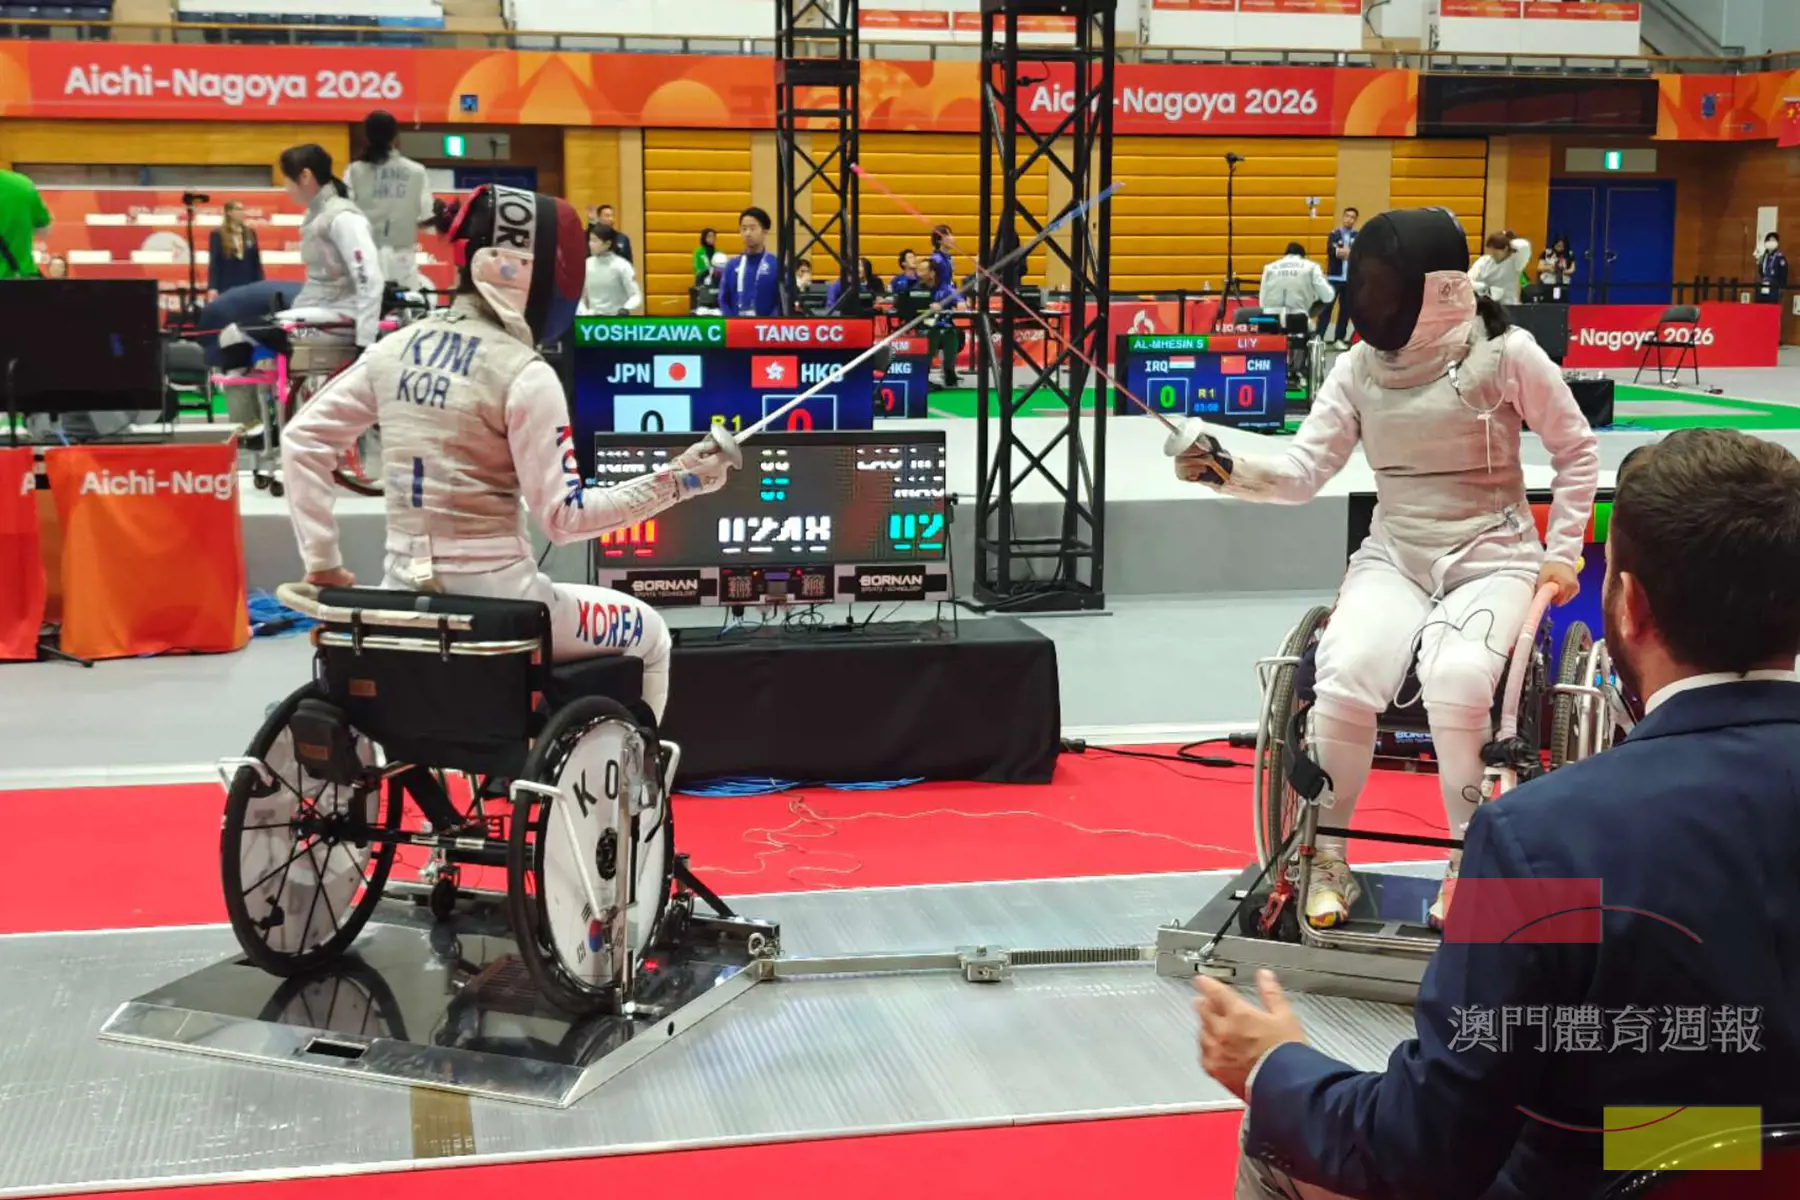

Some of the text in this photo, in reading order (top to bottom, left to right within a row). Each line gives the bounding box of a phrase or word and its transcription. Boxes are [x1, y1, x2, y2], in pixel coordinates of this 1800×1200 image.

[64, 64, 403, 105] Aichi-Nagoya 2026
[1244, 88, 1317, 114] 2026
[579, 324, 722, 342] YOSHIZAWA C
[755, 324, 844, 342] TANG CC
[400, 327, 483, 376] KIM
[606, 363, 650, 383] JPN
[801, 363, 844, 383] HKG
[1145, 360, 1169, 373] IRQ
[1247, 360, 1271, 371] CHN
[1160, 385, 1176, 408] 0
[1238, 385, 1253, 407] 0
[632, 579, 698, 592] BORNAN
[858, 574, 923, 586] BORNAN
[576, 598, 643, 648] KOREA
